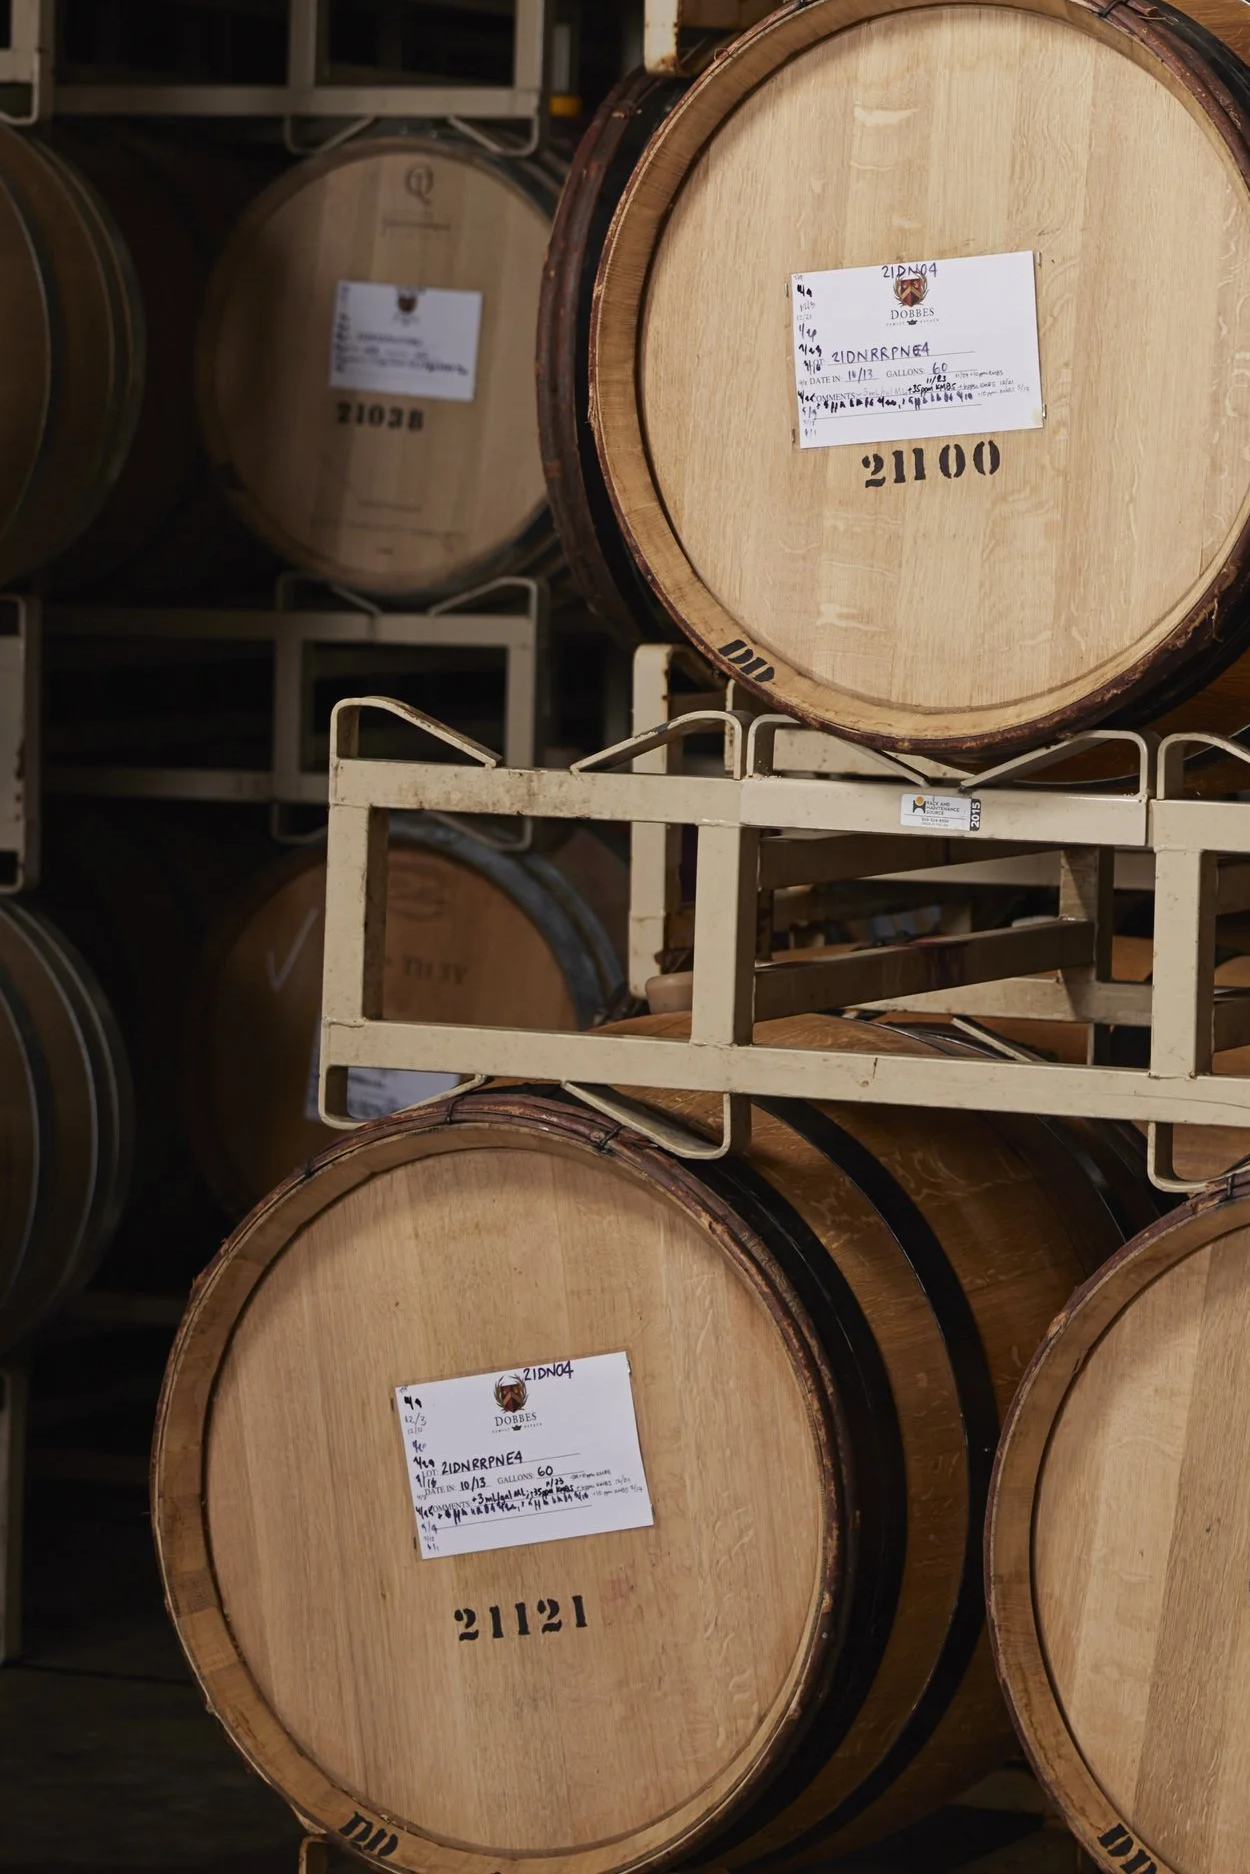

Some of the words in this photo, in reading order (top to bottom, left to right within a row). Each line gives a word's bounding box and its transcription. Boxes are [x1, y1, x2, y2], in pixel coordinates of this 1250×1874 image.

[881, 262, 938, 279] 21DN04
[890, 307, 935, 320] DOBBES
[932, 362, 948, 374] 60
[810, 376, 830, 385] DATE
[861, 439, 1001, 488] 21100
[970, 802, 981, 828] 2015
[523, 1360, 574, 1381] 21DN04
[405, 1412, 427, 1426] 12/3
[494, 1412, 537, 1427] DOBBES
[441, 1450, 523, 1476] 21DNRRPNE4
[537, 1465, 554, 1477] 60
[424, 1486, 445, 1497] DATE
[460, 1476, 486, 1492] 10/13
[454, 1595, 588, 1642] 21121
